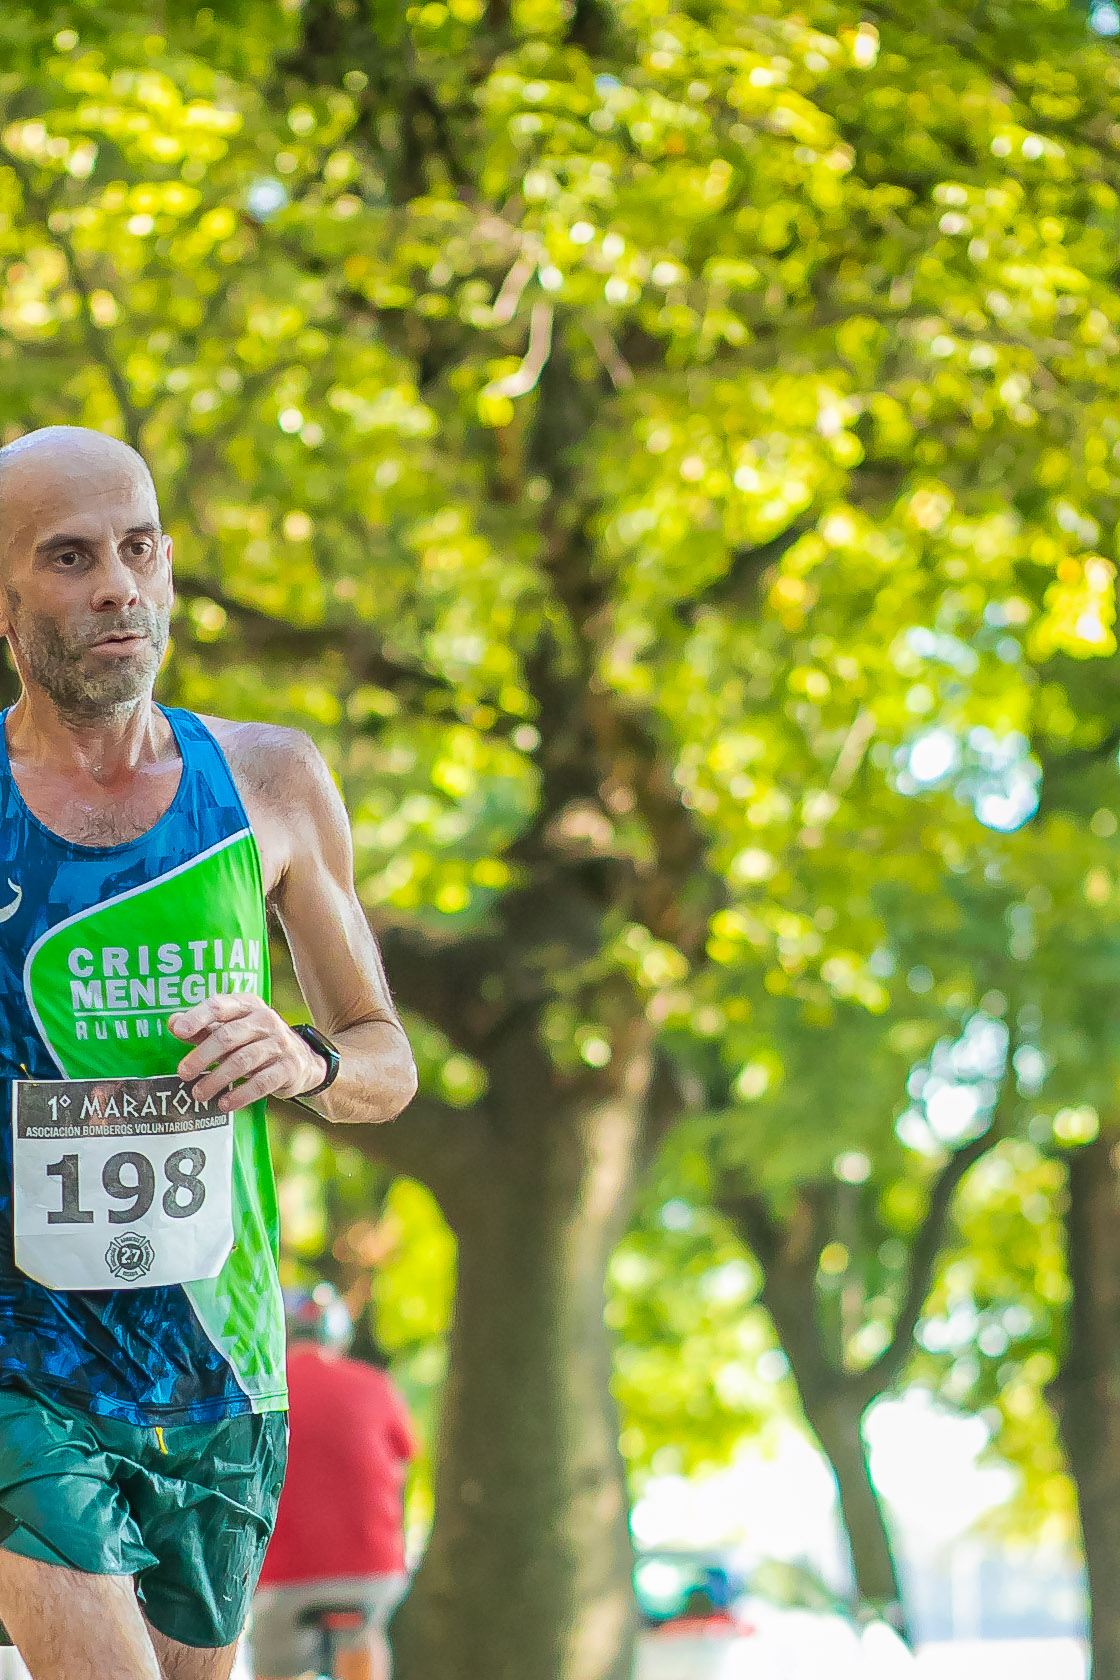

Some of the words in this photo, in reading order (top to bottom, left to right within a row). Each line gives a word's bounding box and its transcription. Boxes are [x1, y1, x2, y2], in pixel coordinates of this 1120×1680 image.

[68, 938, 260, 978] CRISTIAN
[75, 1018, 163, 1040] RUNNI
[25, 1124, 81, 1137] ASOCIACIÓN
[82, 1123, 133, 1136] BOMBEROS
[135, 1120, 194, 1134] VOLUNTARIOS
[195, 1114, 227, 1129] ROSARIO
[46, 1147, 207, 1224] 198
[121, 1247, 141, 1264] 27
